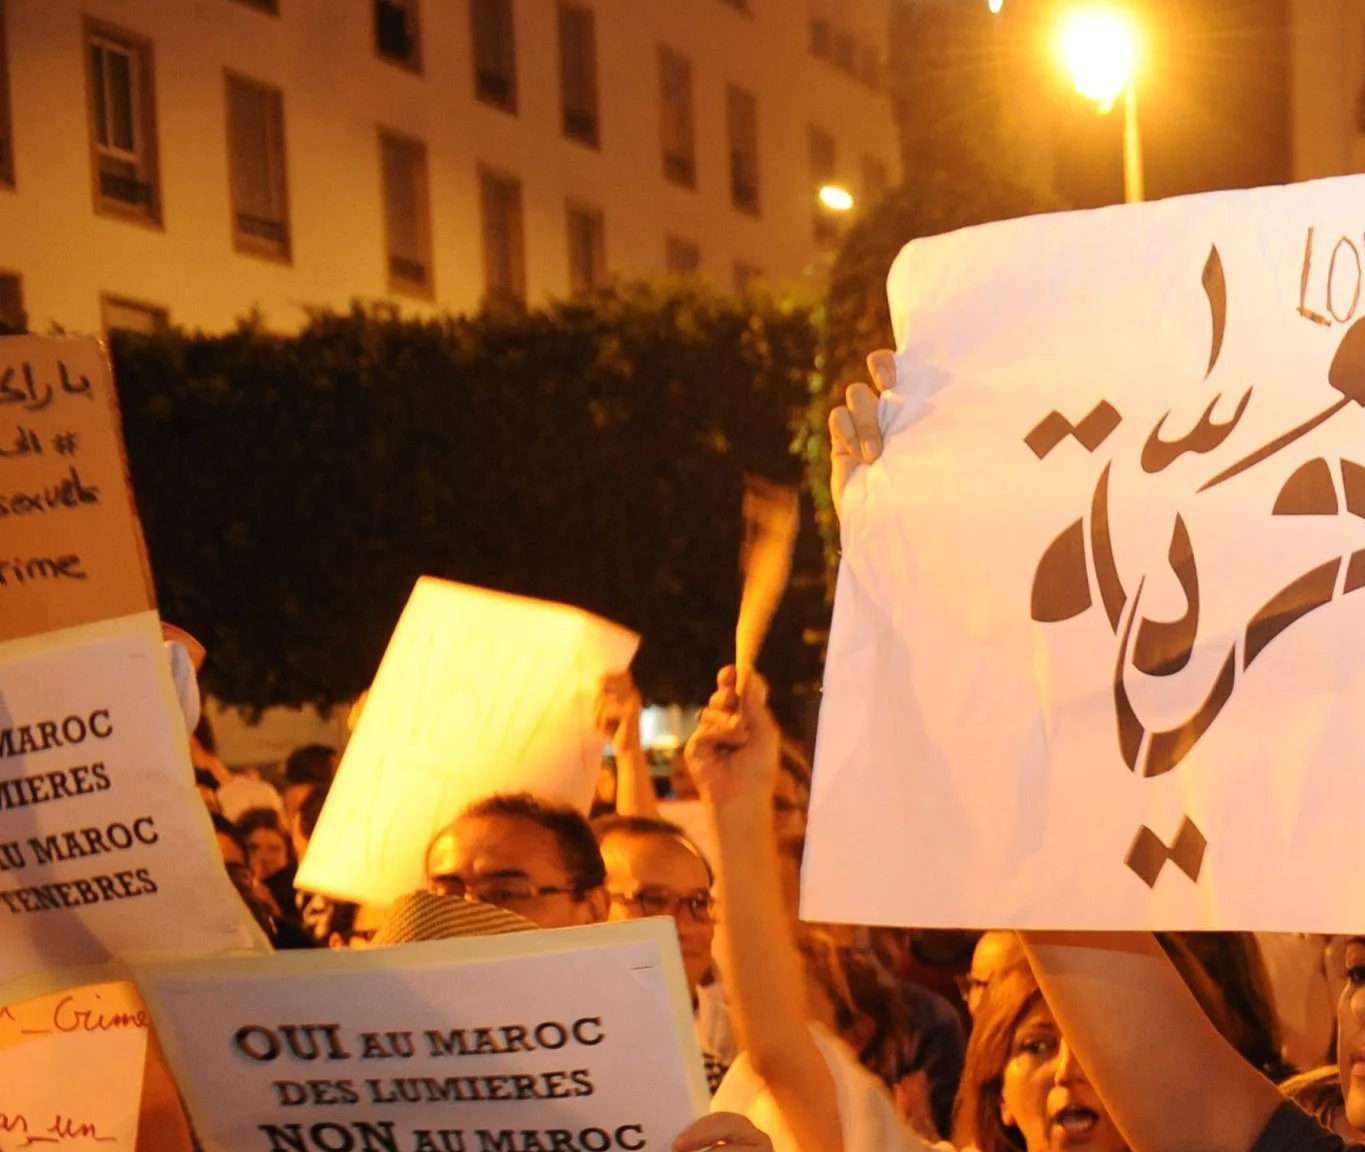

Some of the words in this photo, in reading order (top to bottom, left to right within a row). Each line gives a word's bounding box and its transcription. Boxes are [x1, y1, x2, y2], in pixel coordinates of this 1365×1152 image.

[26, 816, 159, 867] MAROC
[234, 1023, 350, 1062] OUI
[360, 1031, 414, 1060] AU
[425, 1017, 606, 1057] MAROC
[274, 1079, 360, 1107] DES
[365, 1069, 595, 1104] LUMIERES
